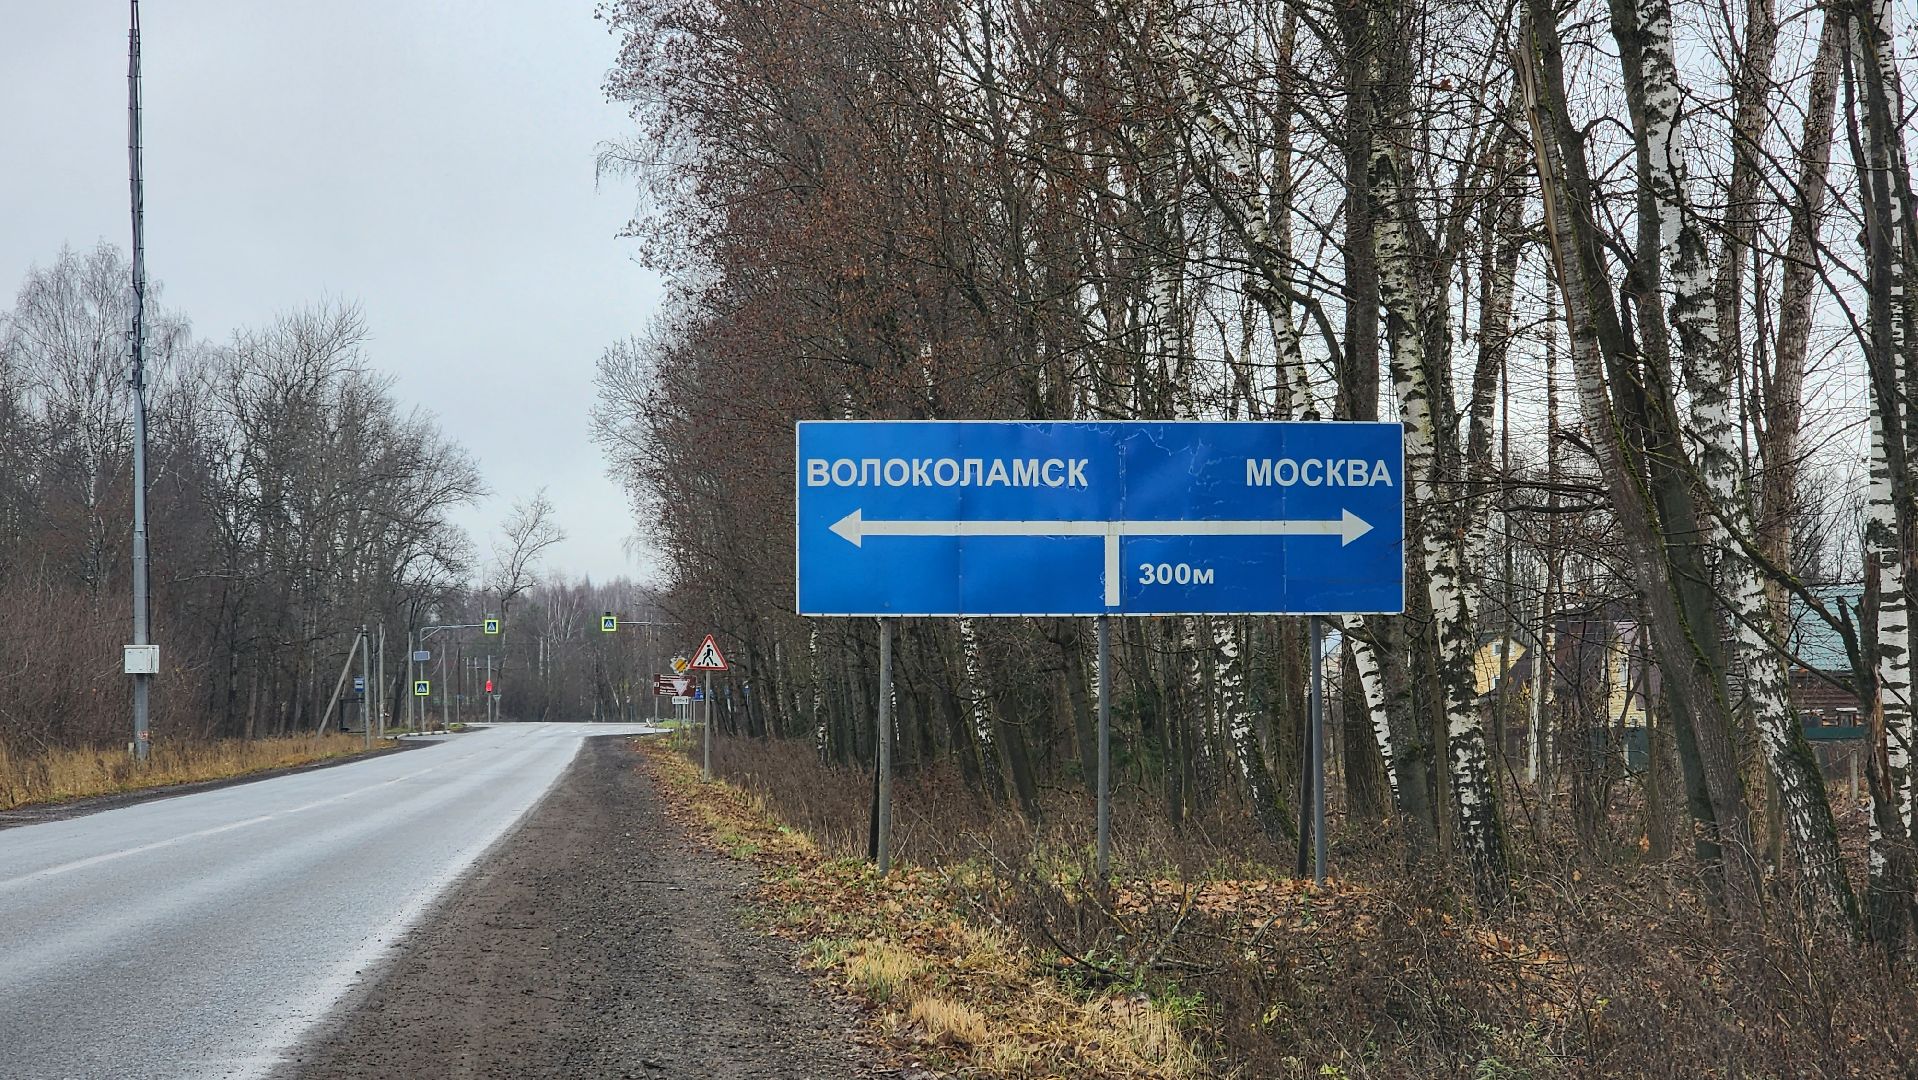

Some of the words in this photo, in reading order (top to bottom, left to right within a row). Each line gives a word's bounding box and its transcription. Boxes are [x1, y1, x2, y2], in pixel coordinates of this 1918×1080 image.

[807, 458, 1089, 487] ВОЛОКОЛАМСК
[1246, 458, 1393, 486] МОСКВА
[1139, 563, 1214, 585] 300м
